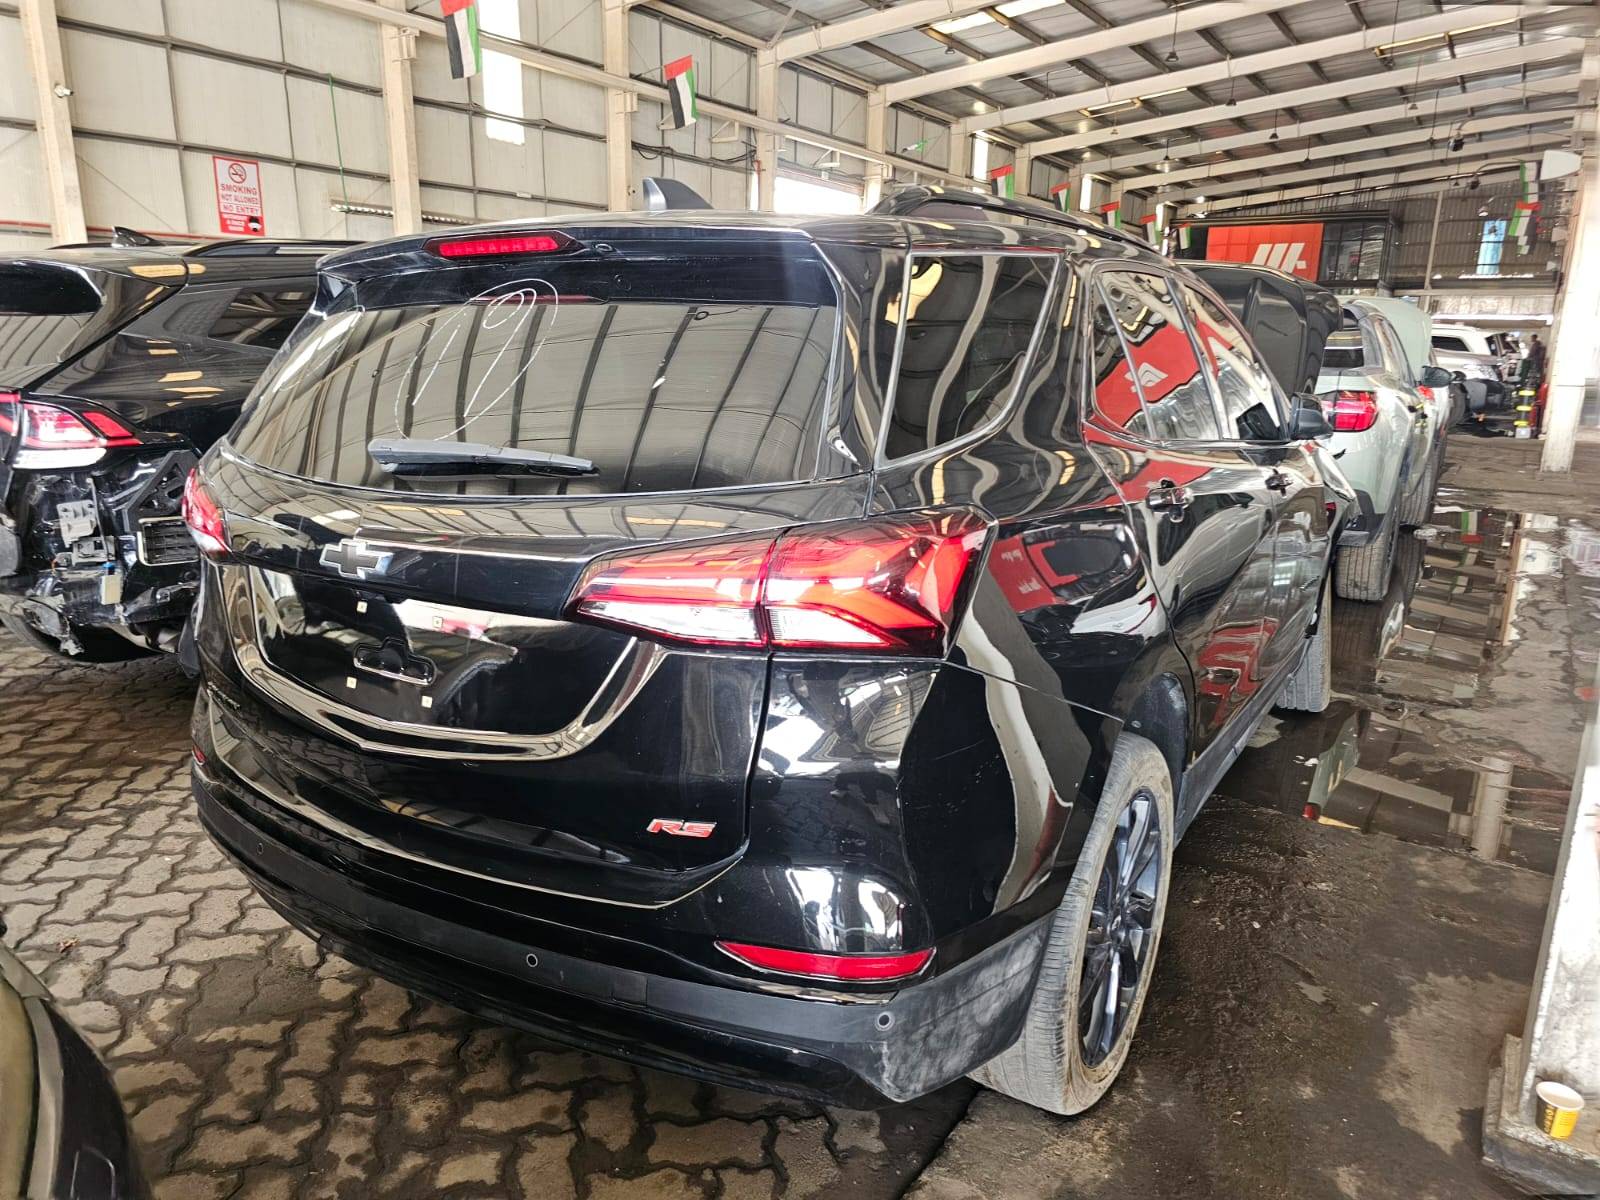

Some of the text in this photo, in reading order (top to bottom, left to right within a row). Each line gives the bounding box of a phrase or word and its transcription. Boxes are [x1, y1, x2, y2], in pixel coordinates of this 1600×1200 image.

[220, 183, 257, 195] SMOKING
[221, 193, 258, 204] NOT ALLOWED
[223, 204, 259, 215] NO ENTRY
[646, 818, 717, 838] RS
